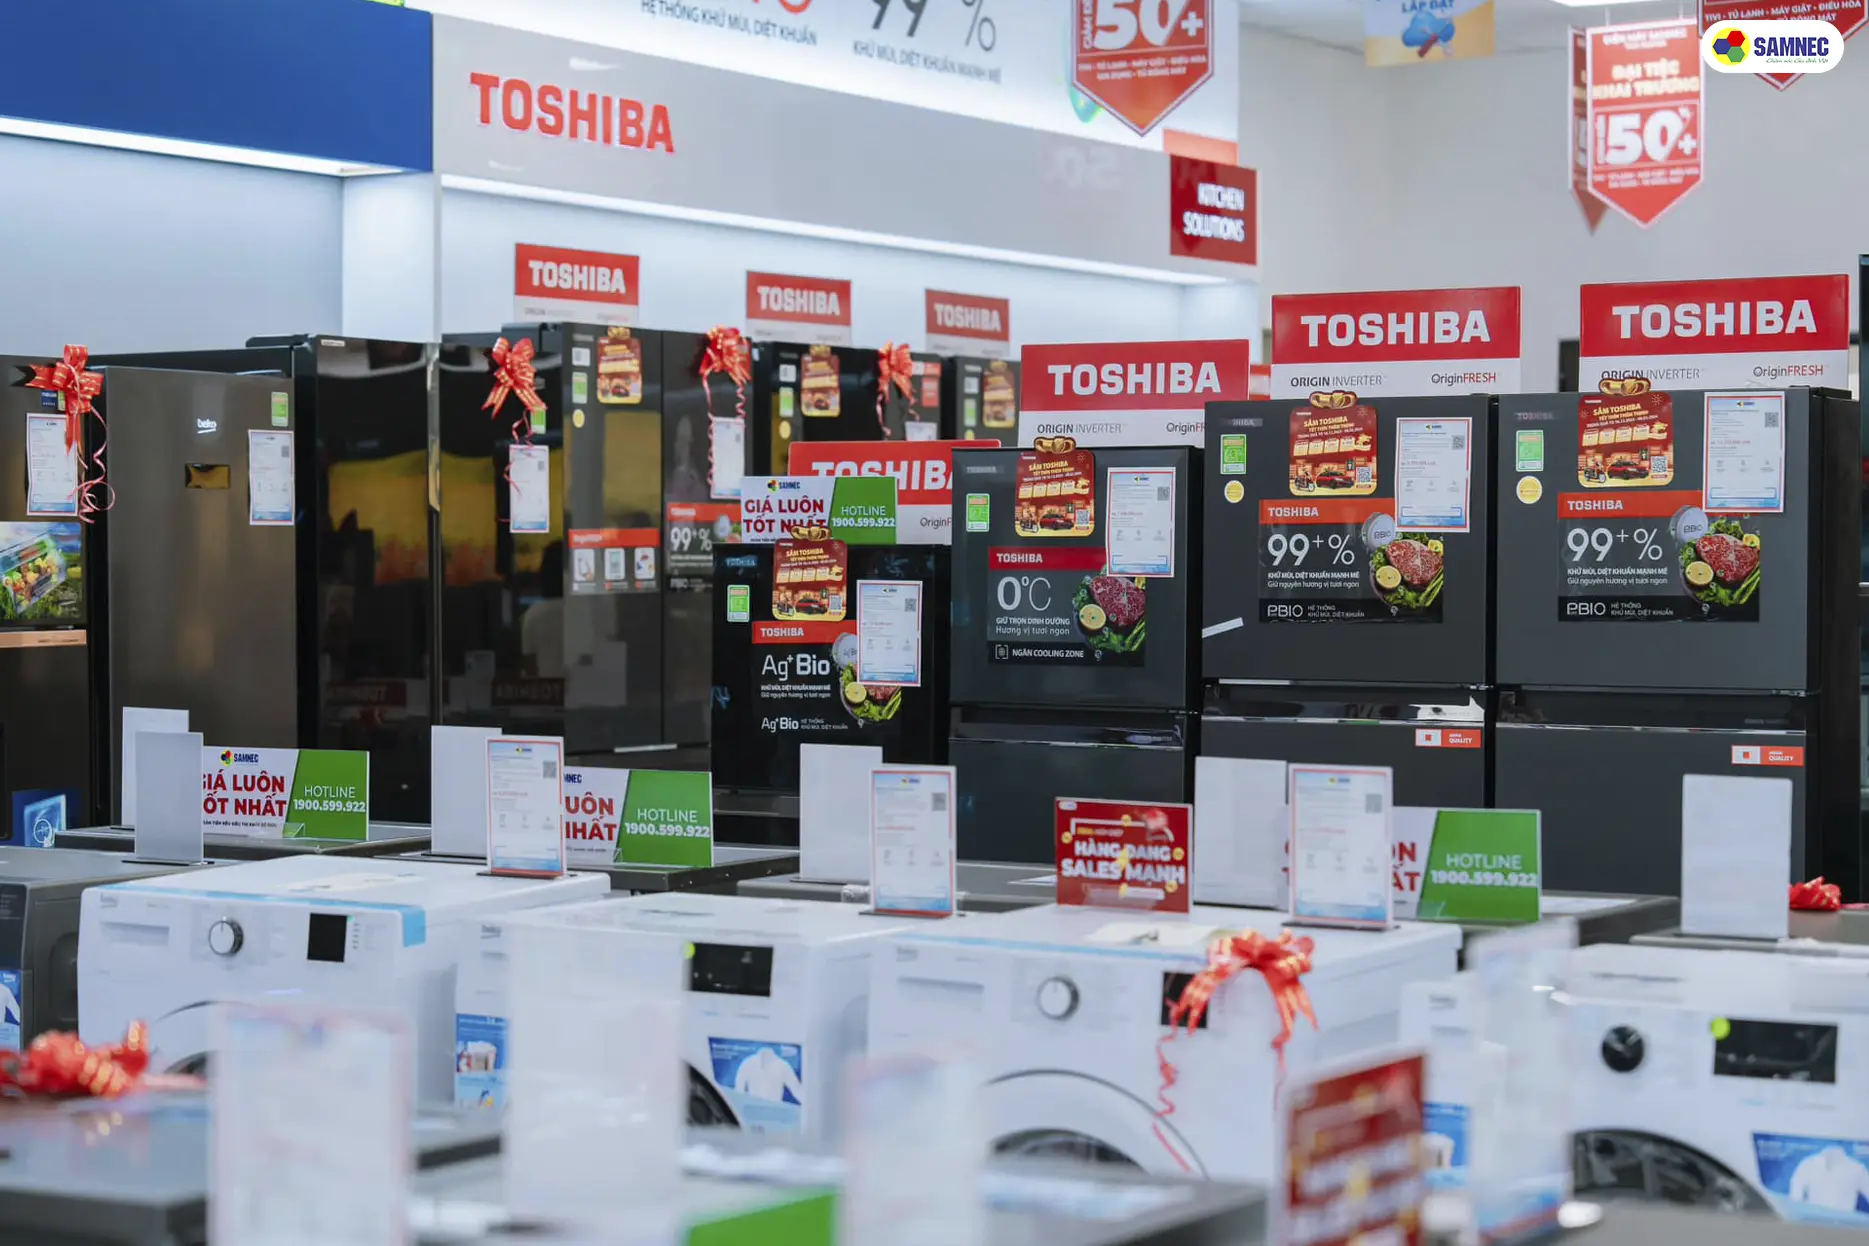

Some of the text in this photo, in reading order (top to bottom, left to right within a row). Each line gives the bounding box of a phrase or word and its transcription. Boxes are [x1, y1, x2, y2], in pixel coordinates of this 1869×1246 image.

[470, 72, 675, 153] TOSHIBA
[1197, 182, 1245, 211] KITCHEN
[1183, 211, 1246, 242] SOLUTIONS
[528, 260, 627, 295] TOSHIBA
[757, 285, 841, 316] TOSHIBA
[933, 302, 1002, 332] TOSHIBA
[1611, 300, 1818, 339] TOSHIBA
[1301, 310, 1491, 347] TOSHIBA
[1047, 362, 1222, 396] TOSHIBA
[1290, 374, 1383, 387] ORIGIN INVERTER
[1431, 372, 1497, 388] OriginFRESH
[1645, 368, 1700, 381] INVERTER
[1753, 365, 1823, 380] OriginFRESH
[1037, 423, 1122, 434] ORIGIN INVERTER
[744, 494, 824, 514] GIÁ LUÔN
[841, 506, 886, 516] HOTLINE
[1268, 506, 1319, 517] TOSHIBA
[1567, 500, 1624, 511] TOSHIBA
[743, 514, 776, 534] TỐT
[832, 517, 896, 528] 1900.599.922
[996, 553, 1043, 564] TOSHIBA
[760, 628, 804, 638] TOSHIBA
[1050, 628, 1070, 636] ngon
[1012, 648, 1084, 658] NGĂN COOLING ZONE
[234, 752, 259, 762] SAMNEC
[203, 768, 285, 793] IÁ LUÔN
[304, 785, 356, 798] HOTLINE
[203, 791, 287, 817] ỐT NHẤT
[293, 799, 366, 813] 1900.599.922
[637, 808, 698, 823] HOTLINE
[625, 822, 710, 838] 1900.599.922
[1074, 837, 1122, 858] HÀNG
[1062, 858, 1122, 880] SALES
[1446, 853, 1522, 870] HOTLINE
